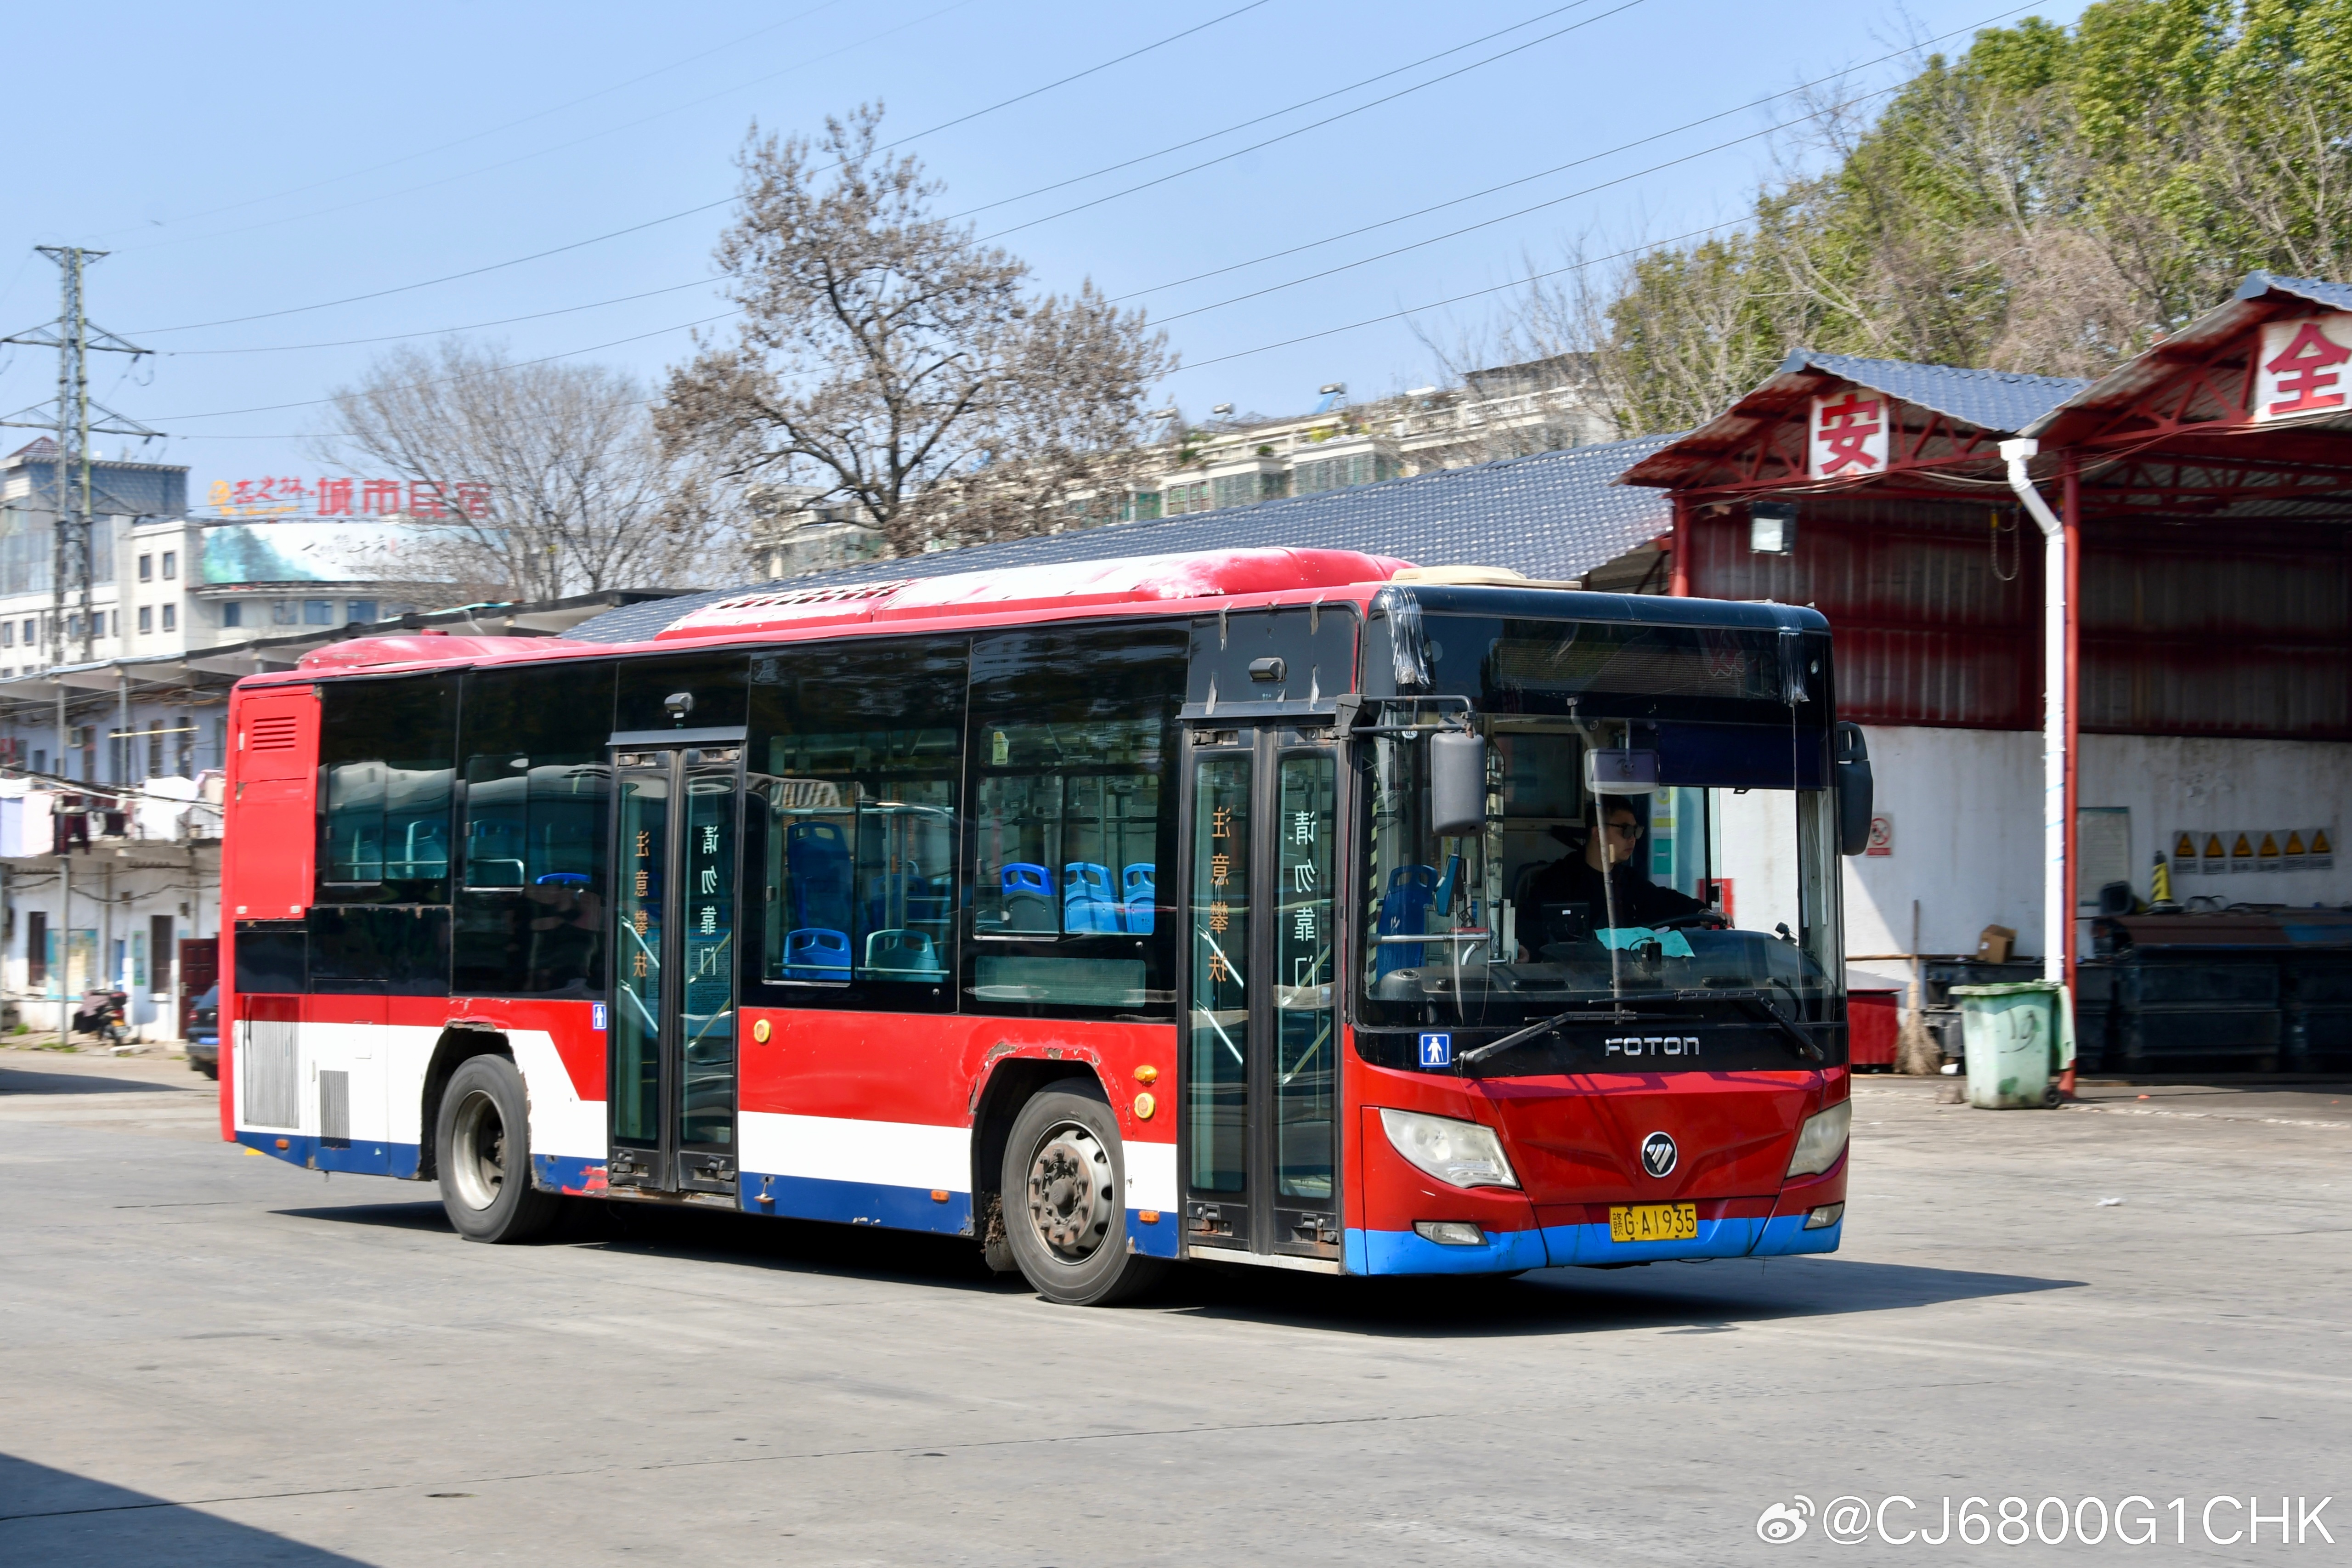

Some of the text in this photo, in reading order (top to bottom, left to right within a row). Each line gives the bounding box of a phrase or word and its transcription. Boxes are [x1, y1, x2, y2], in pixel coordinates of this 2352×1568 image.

[2266, 323, 2352, 414] 全
[1818, 394, 1879, 475] 安
[317, 477, 490, 518] 城市民宿
[1605, 1037, 1699, 1056] FOTON
